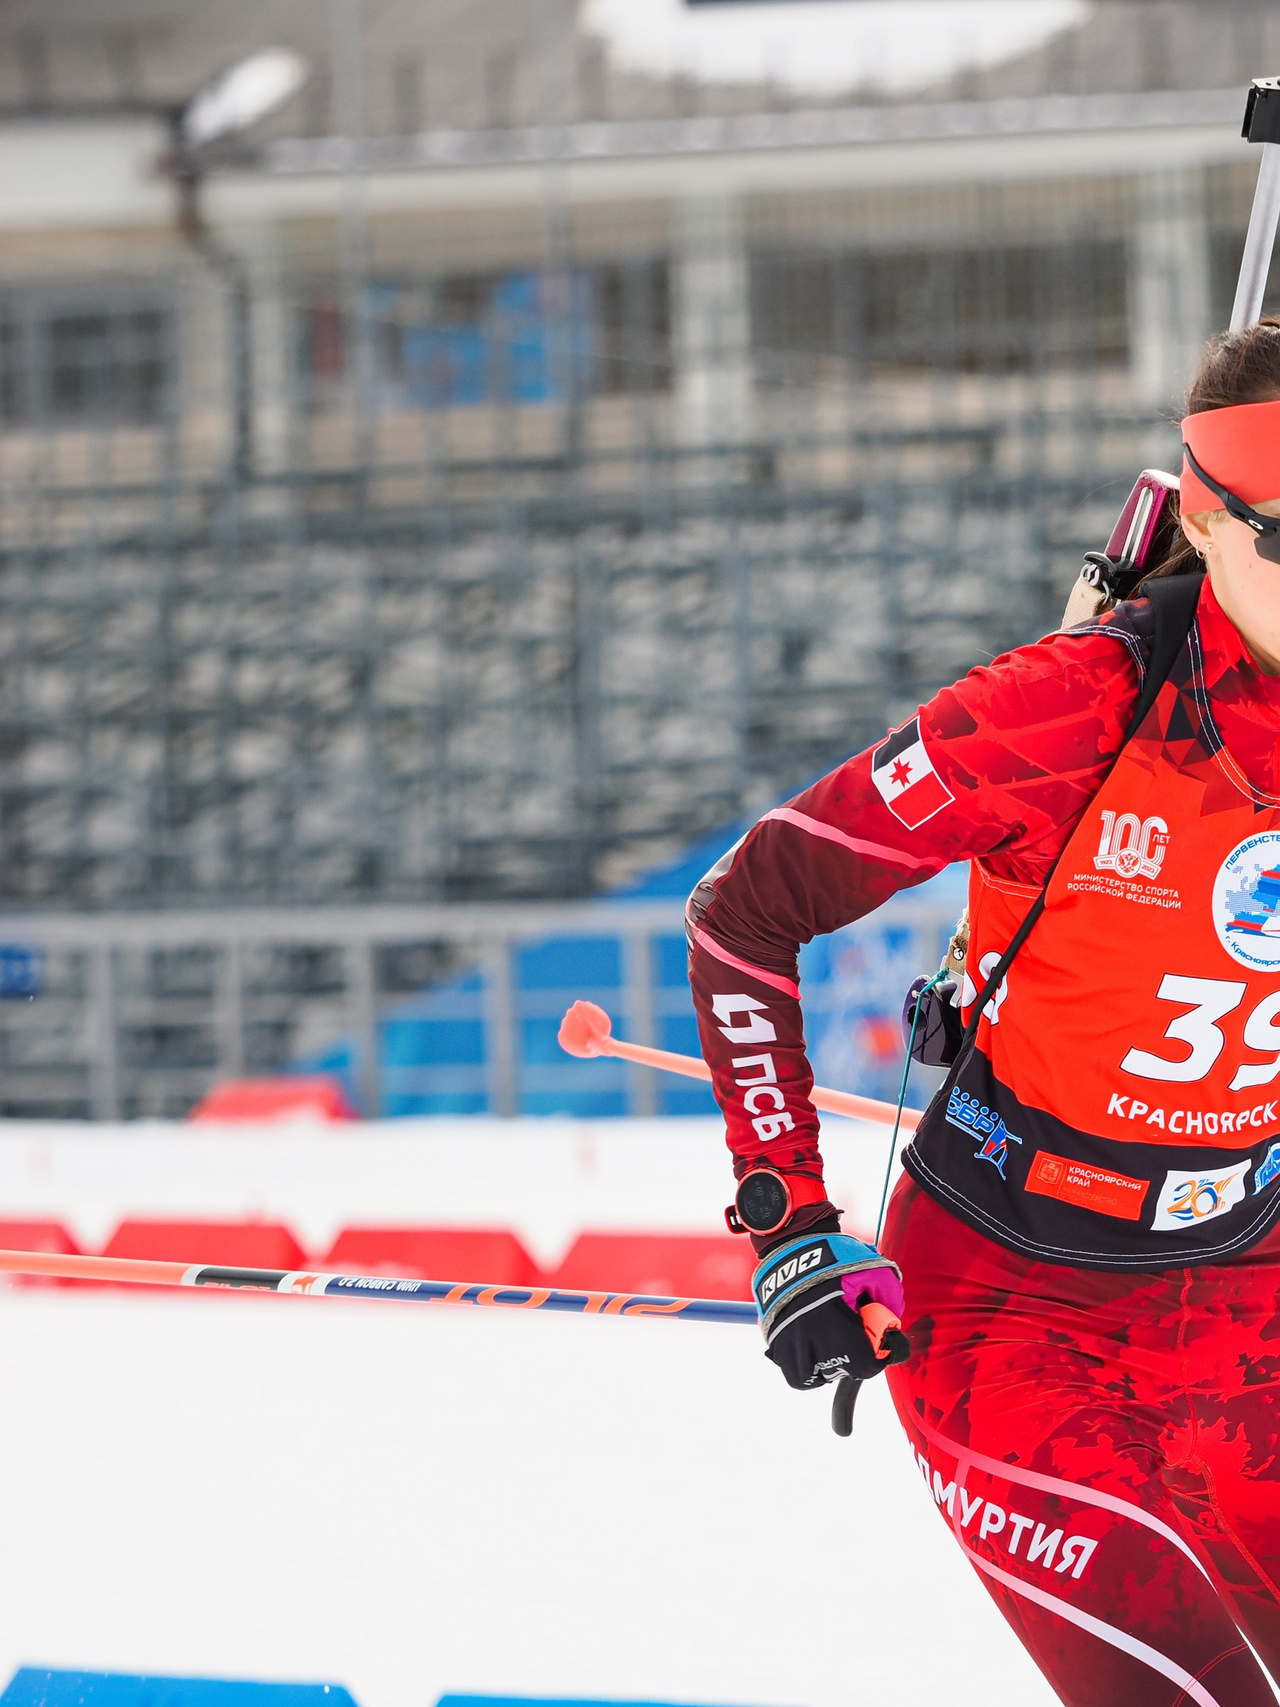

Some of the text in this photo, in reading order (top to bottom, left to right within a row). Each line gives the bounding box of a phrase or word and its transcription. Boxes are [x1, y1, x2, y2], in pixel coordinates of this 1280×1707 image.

[1098, 809, 1168, 867] 100
[1152, 834, 1171, 844] ЛЕТ
[1067, 882, 1182, 910] РОССИЙСКОЙ ФЕДЕРАЦИИ
[1073, 873, 1179, 898] МИНИСТЕРСТВО СПОРТА
[731, 1052, 796, 1142] ПСБ
[1106, 1093, 1279, 1135] КРАСНОЯРСК
[1066, 1175, 1091, 1187] КРАЙ
[1069, 1166, 1141, 1190] КРАСНОЯРСКИЙ
[354, 1278, 398, 1291] CARBON
[429, 1283, 698, 1320] PILOT
[910, 1440, 1098, 1580] ДМУРТИЯ
